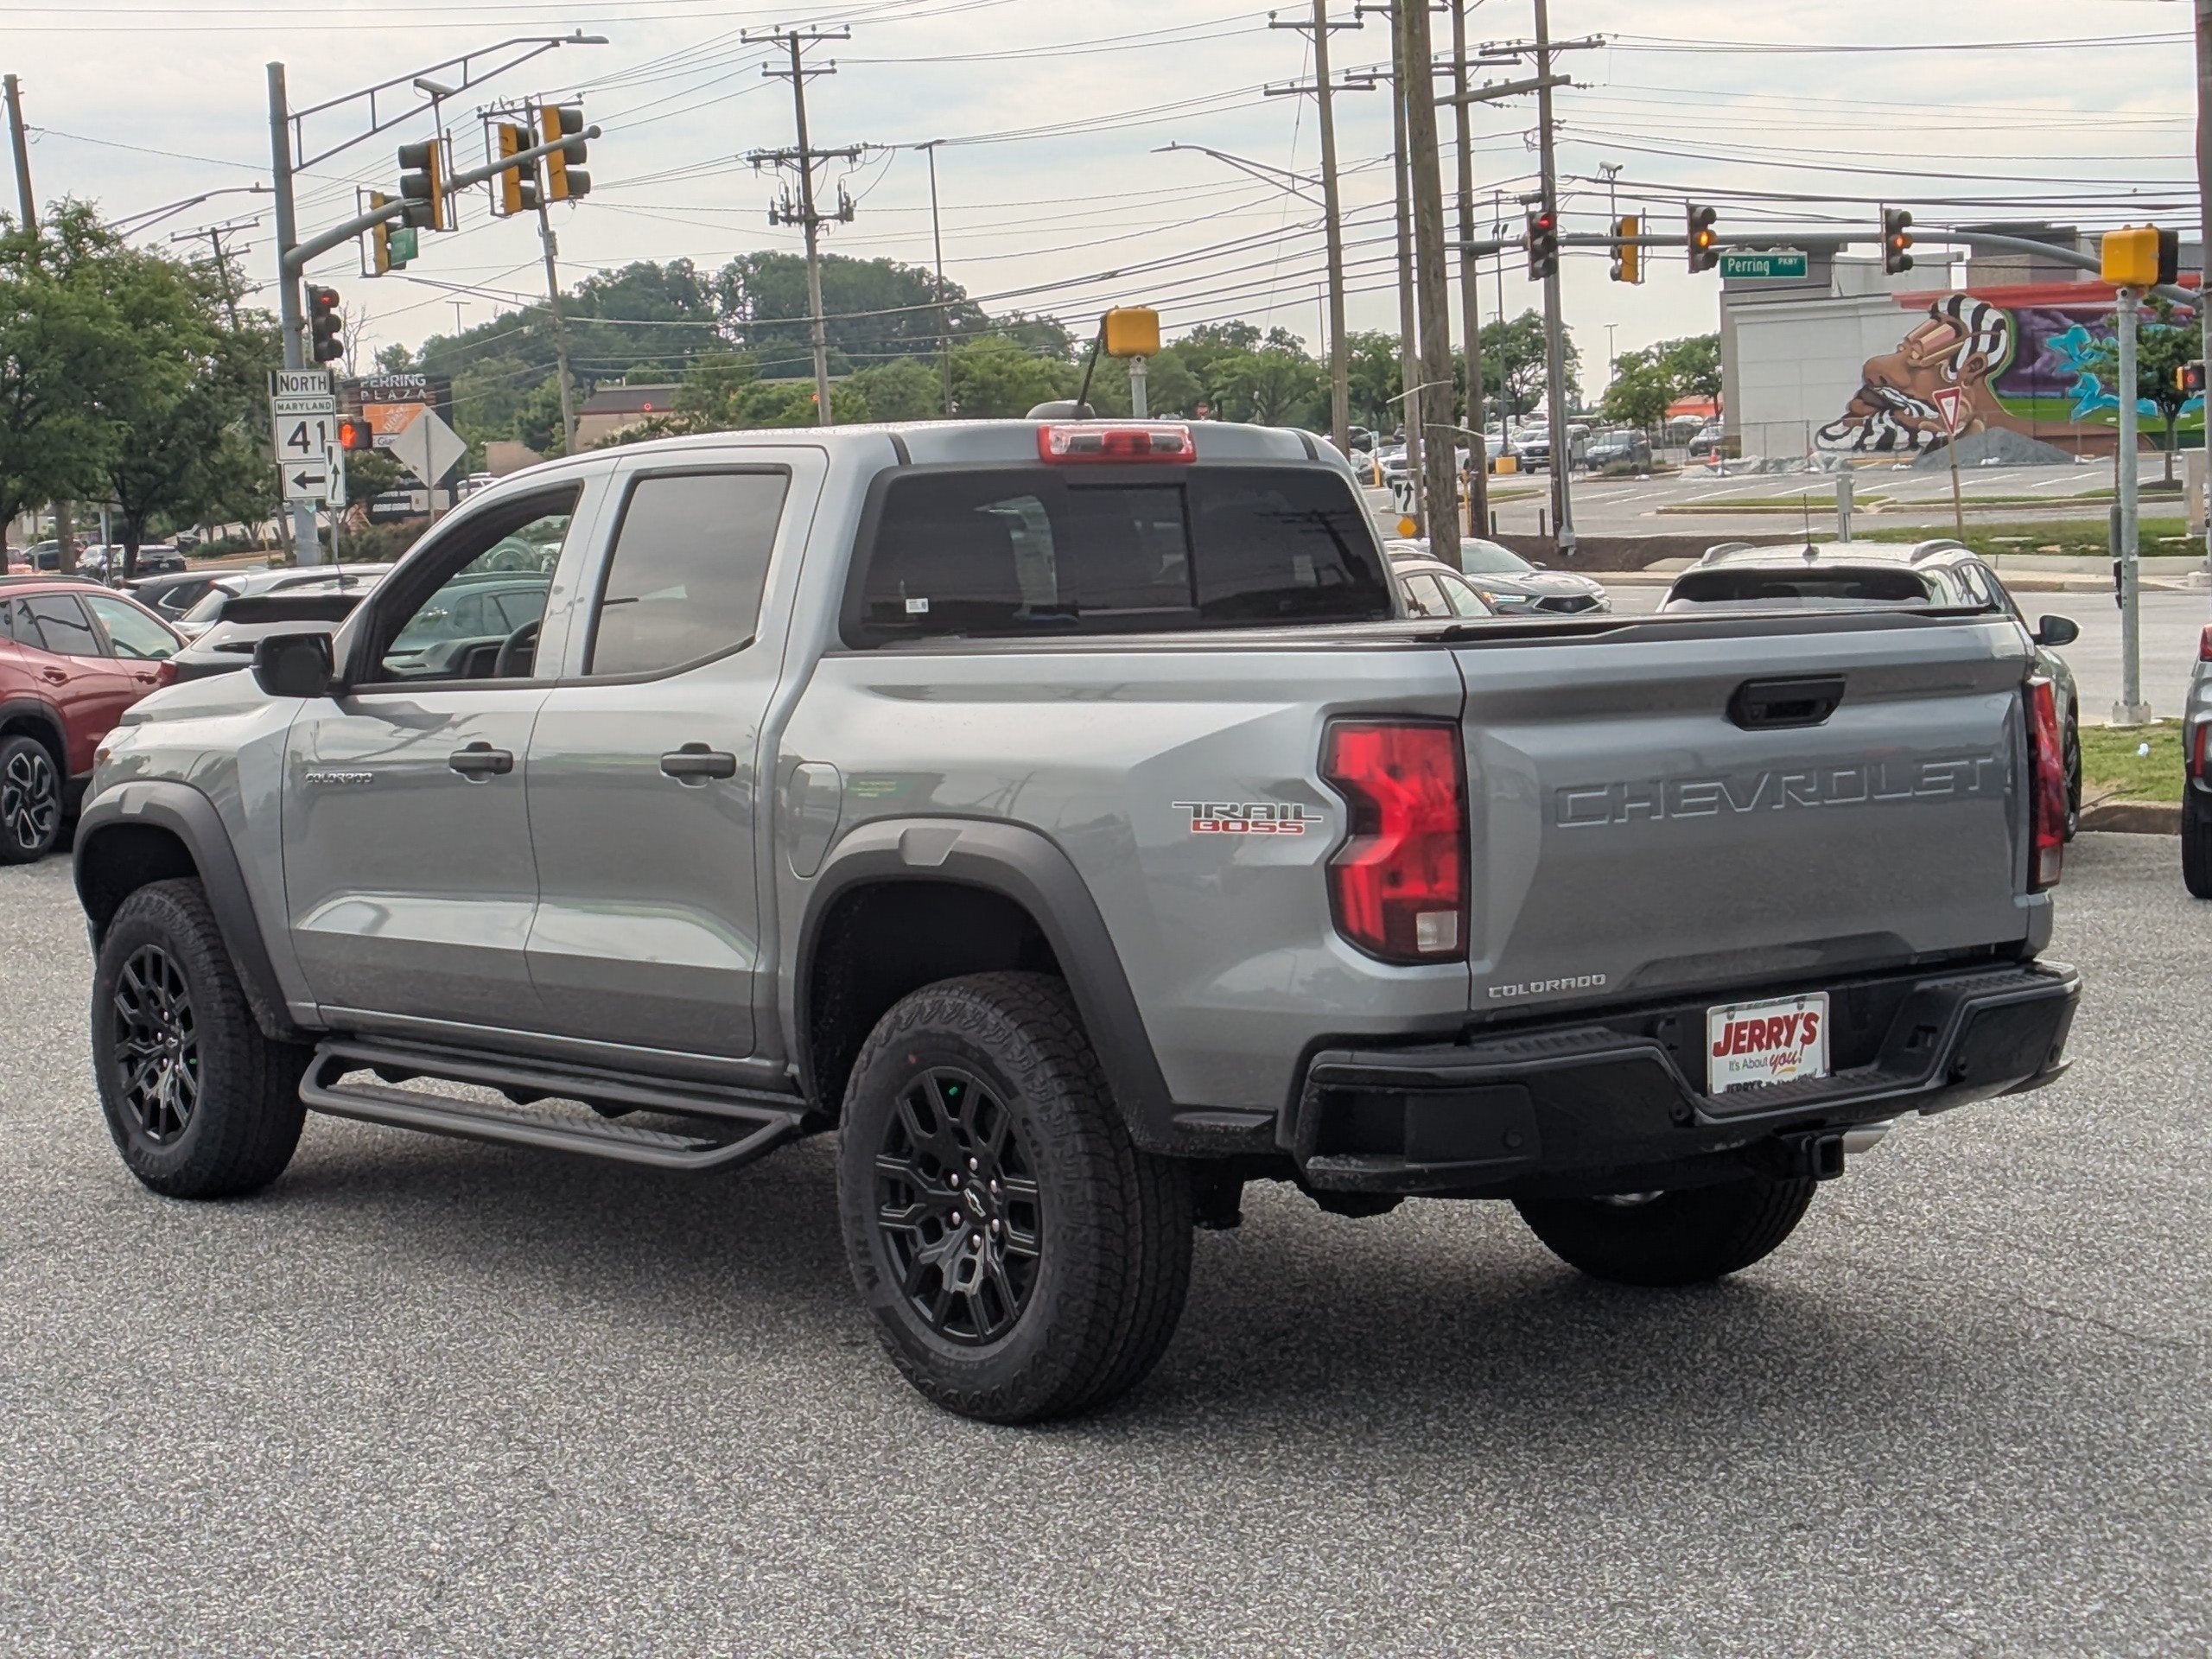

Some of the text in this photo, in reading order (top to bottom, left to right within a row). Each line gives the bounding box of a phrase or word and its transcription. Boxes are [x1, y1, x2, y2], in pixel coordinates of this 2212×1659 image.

[1728, 257, 1770, 276] Perring
[280, 374, 327, 392] NORTH
[359, 372, 427, 388] PERRING
[360, 389, 427, 401] PLAZA
[277, 401, 332, 411] MARYLAND
[287, 420, 326, 454] 41
[305, 772, 372, 783] COLORADO
[1554, 757, 1994, 828] CHEVROLET
[1172, 801, 1324, 823] TRAIL
[1191, 819, 1306, 836] BOSS
[1488, 973, 1607, 999] COLORADO
[1712, 1011, 1821, 1058] JERRY'S
[1728, 1043, 1806, 1075] It's About you!
